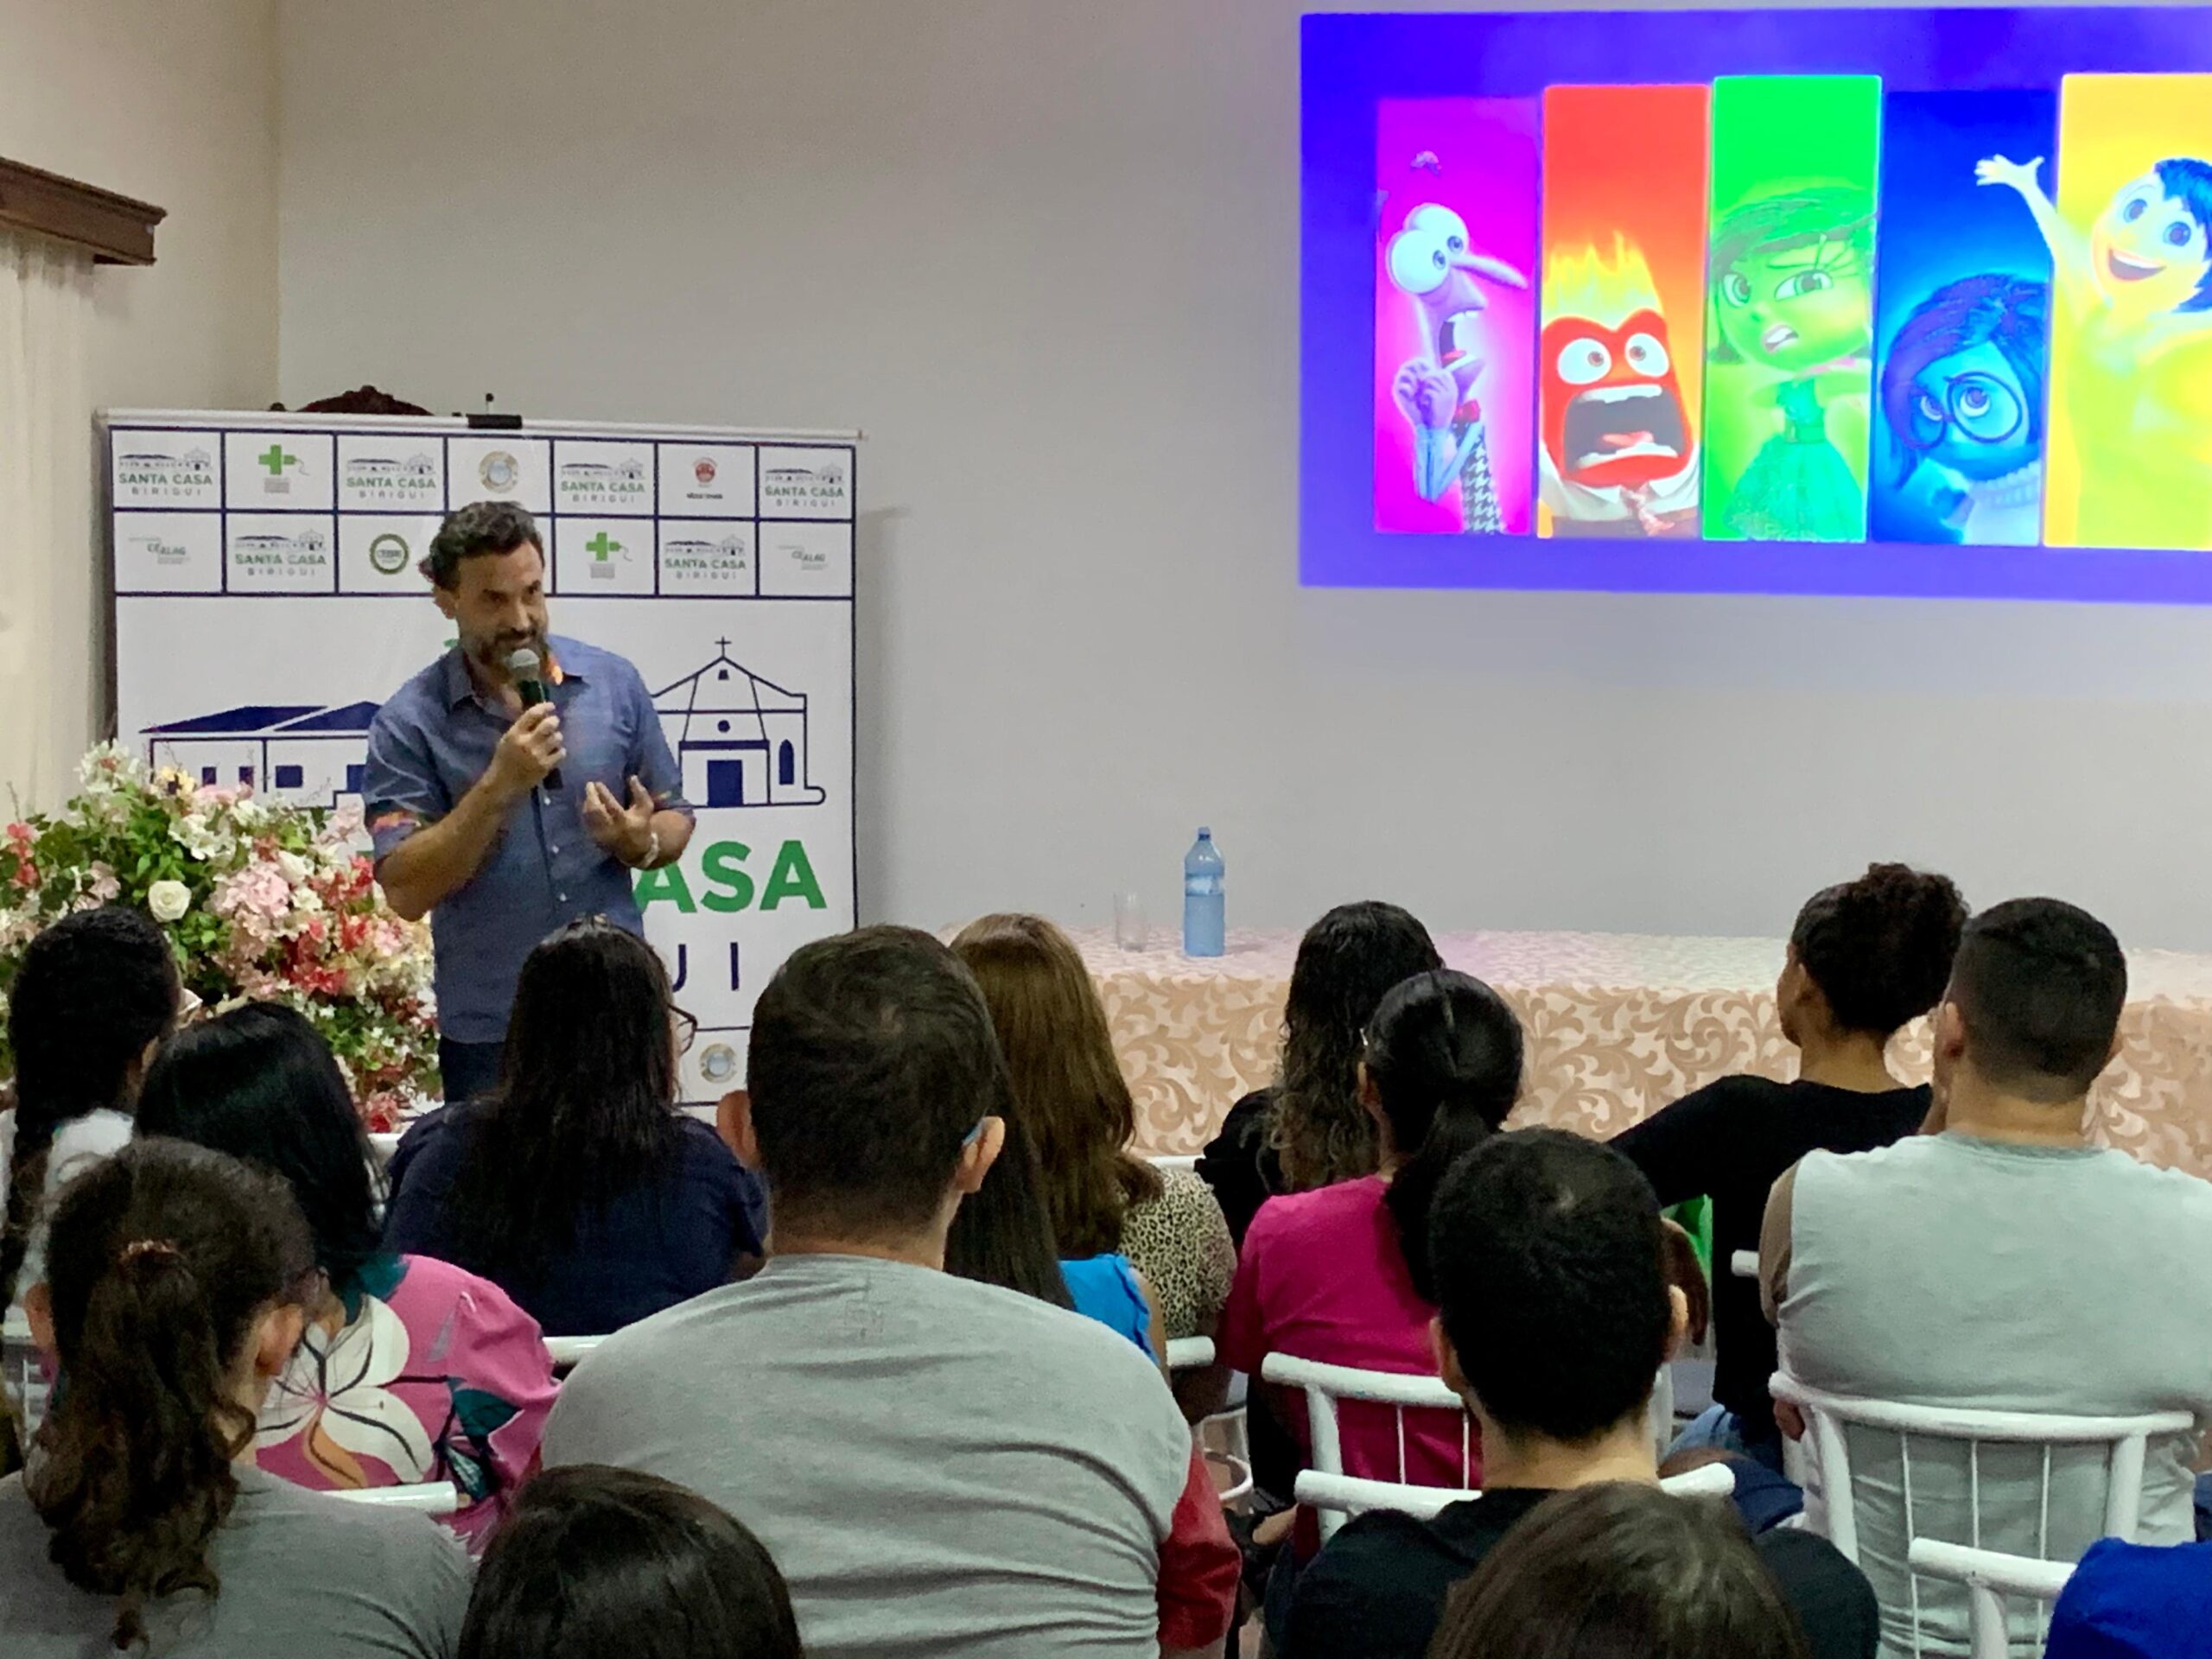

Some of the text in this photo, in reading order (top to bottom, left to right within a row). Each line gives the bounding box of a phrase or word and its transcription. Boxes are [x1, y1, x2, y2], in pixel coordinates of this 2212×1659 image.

[118, 473, 213, 485] SANTA CASA
[346, 476, 436, 489] SANTA CASA
[131, 486, 200, 497] BIRIGUI
[561, 480, 645, 493] SANTA CASA
[765, 485, 844, 497] SANTA CASA
[359, 490, 424, 499] BIRIGUI
[573, 493, 634, 503] BIRIGUI
[776, 499, 835, 507] BIRIGUI
[235, 554, 327, 565] SANTA CASA
[664, 557, 747, 569] SANTA CASA
[247, 568, 315, 576] BIRIGUI
[677, 571, 737, 580] BIRIGUI
[633, 840, 828, 913] ASA
